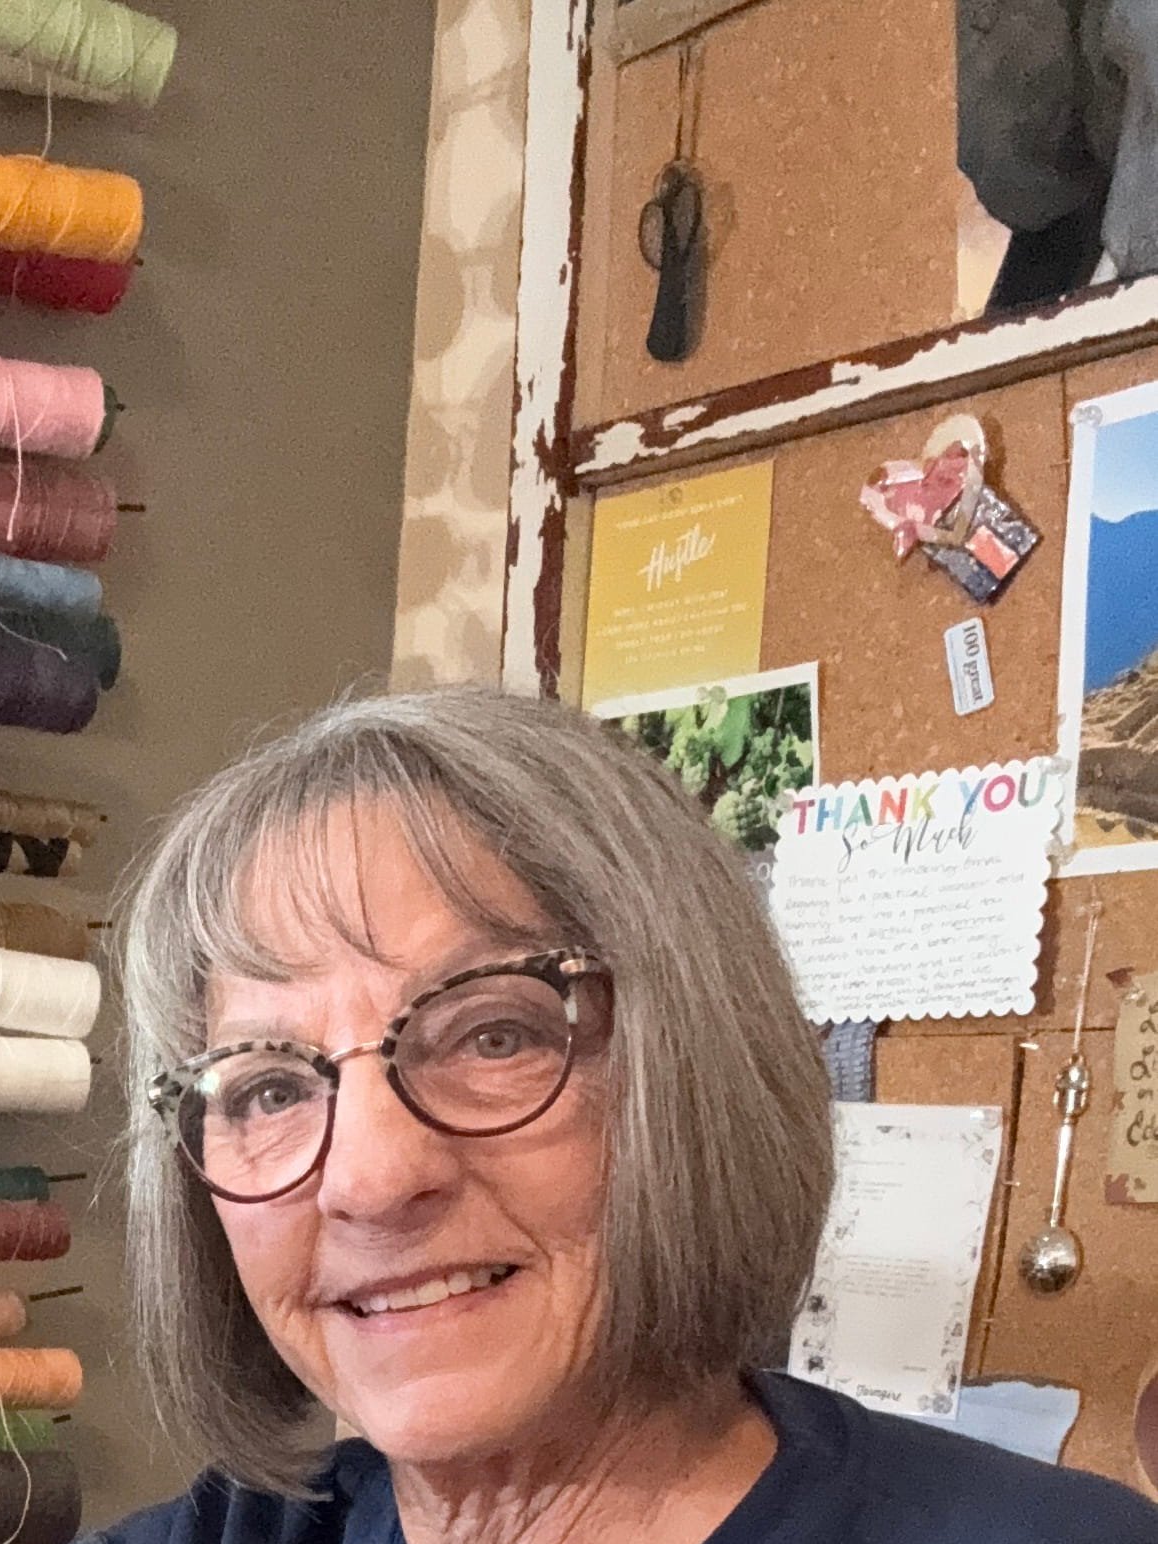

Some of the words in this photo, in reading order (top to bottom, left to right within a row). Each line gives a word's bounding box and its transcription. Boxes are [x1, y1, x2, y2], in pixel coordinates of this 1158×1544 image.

[637, 522, 717, 592] Hustle
[962, 623, 981, 658] 100
[792, 784, 939, 835] THANK
[959, 772, 1048, 816] YOU
[837, 818, 882, 874] So
[891, 796, 979, 864] Much
